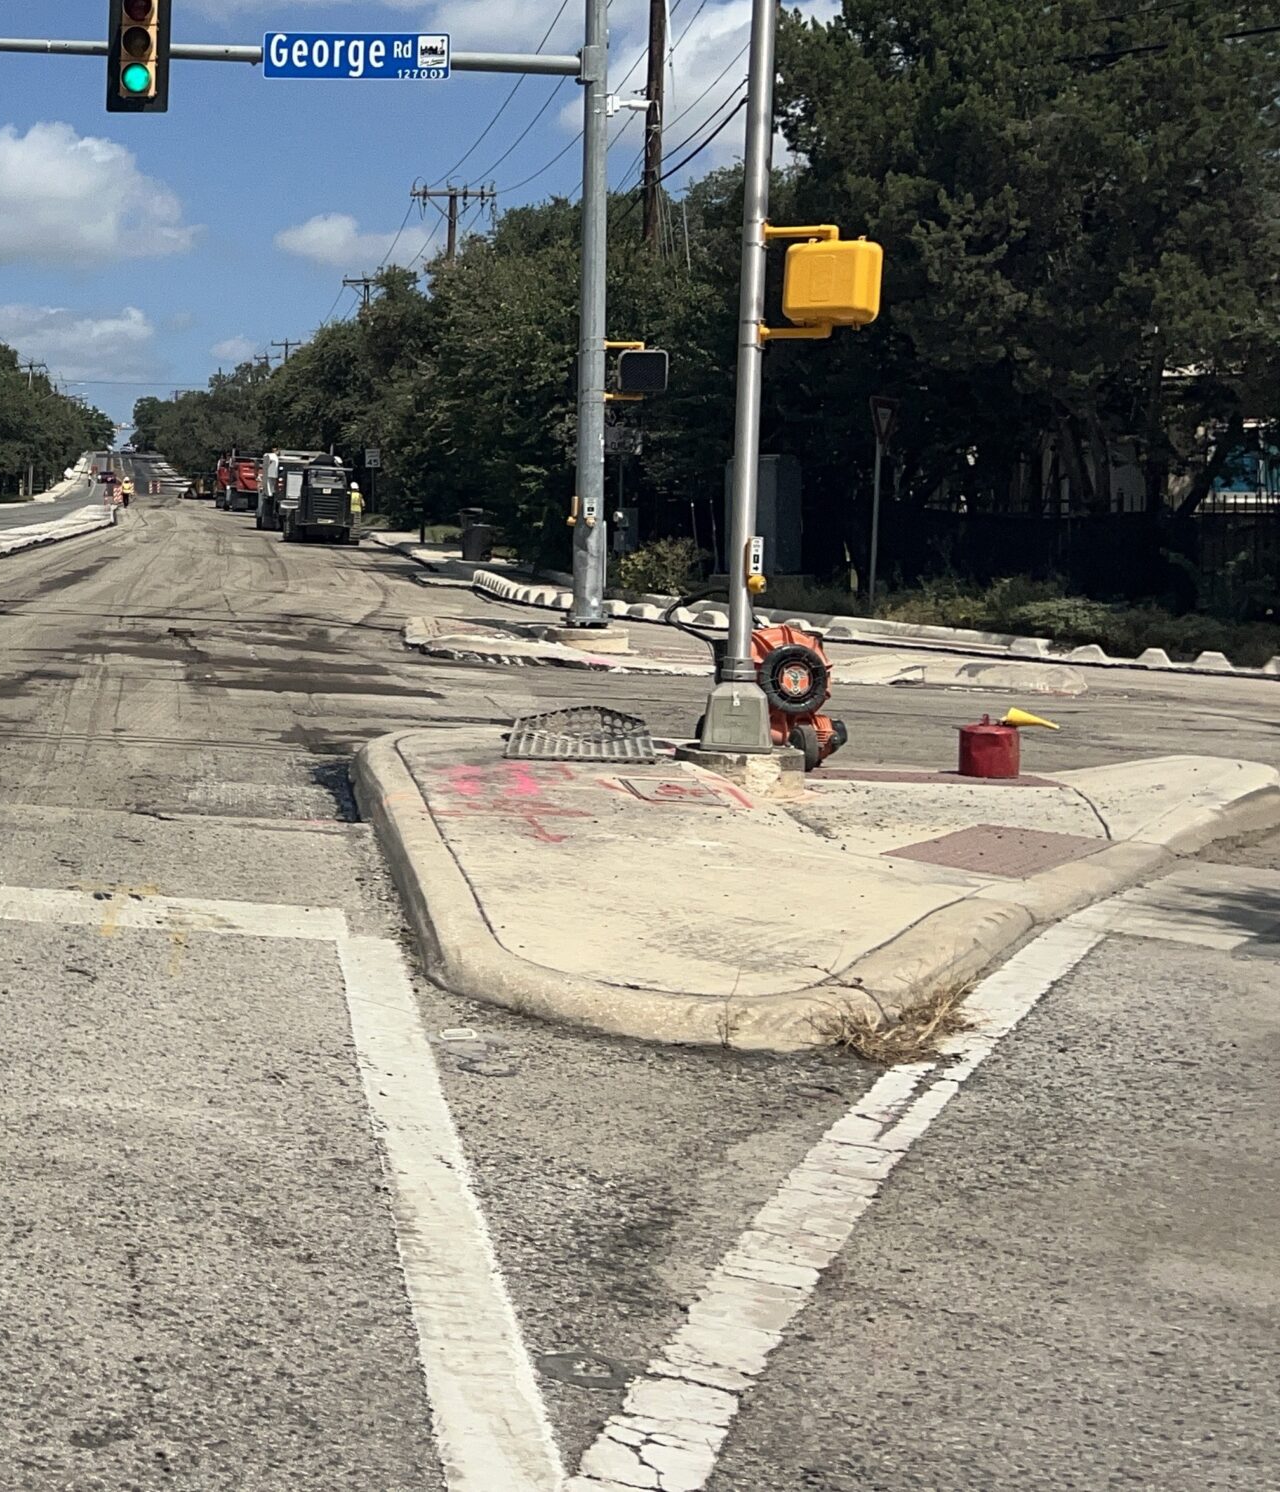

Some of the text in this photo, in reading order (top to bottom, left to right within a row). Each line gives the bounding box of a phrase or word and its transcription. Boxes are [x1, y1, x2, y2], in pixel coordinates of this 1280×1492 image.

[270, 34, 412, 78] George Rd
[397, 69, 438, 79] 12700
